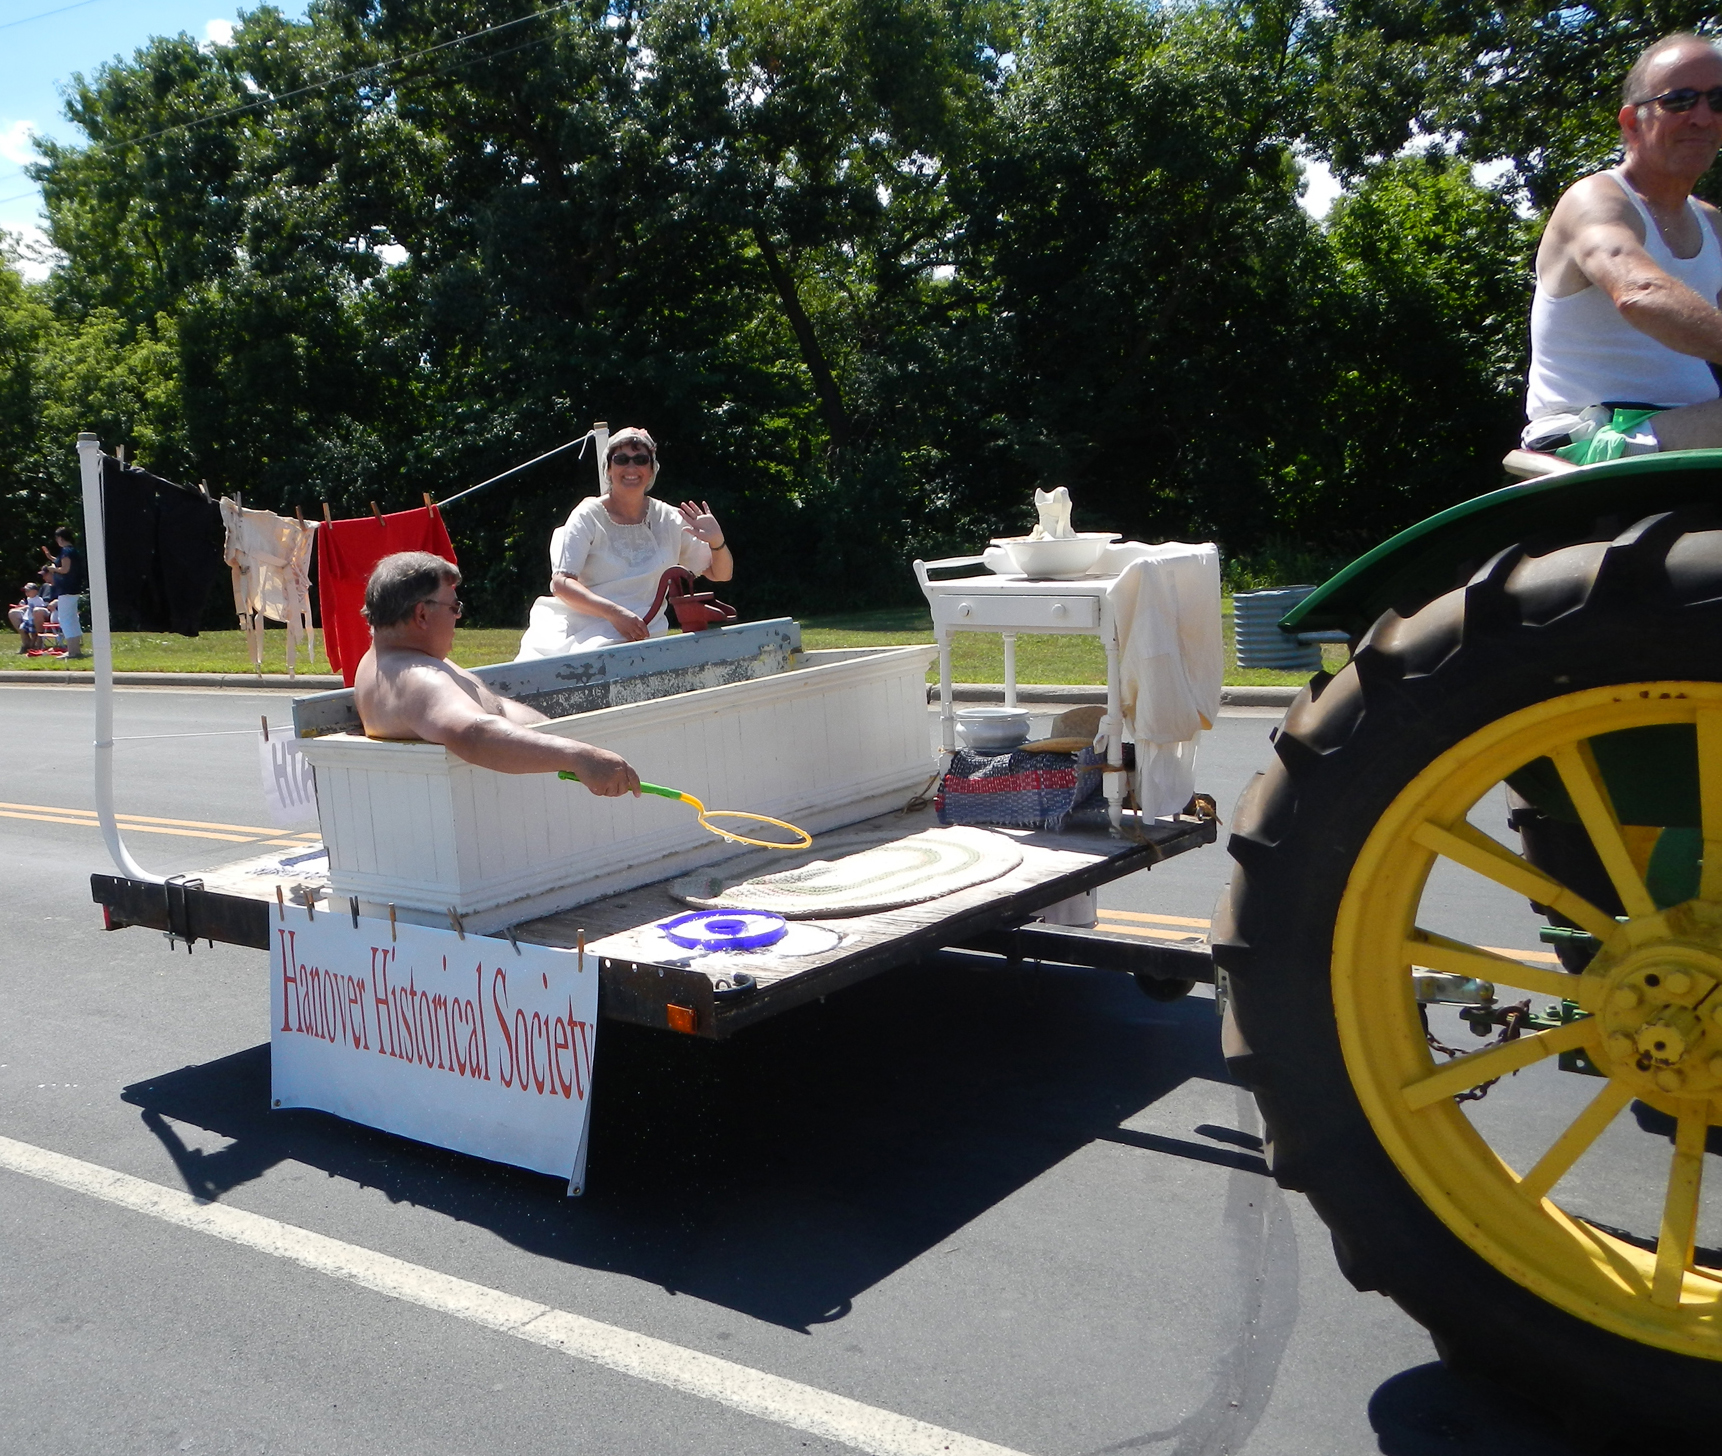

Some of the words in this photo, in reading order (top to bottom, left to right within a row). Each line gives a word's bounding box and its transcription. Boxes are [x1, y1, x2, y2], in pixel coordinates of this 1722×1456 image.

[278, 929, 370, 1050] Hanover
[371, 946, 491, 1081] Historical
[492, 967, 594, 1100] Society
